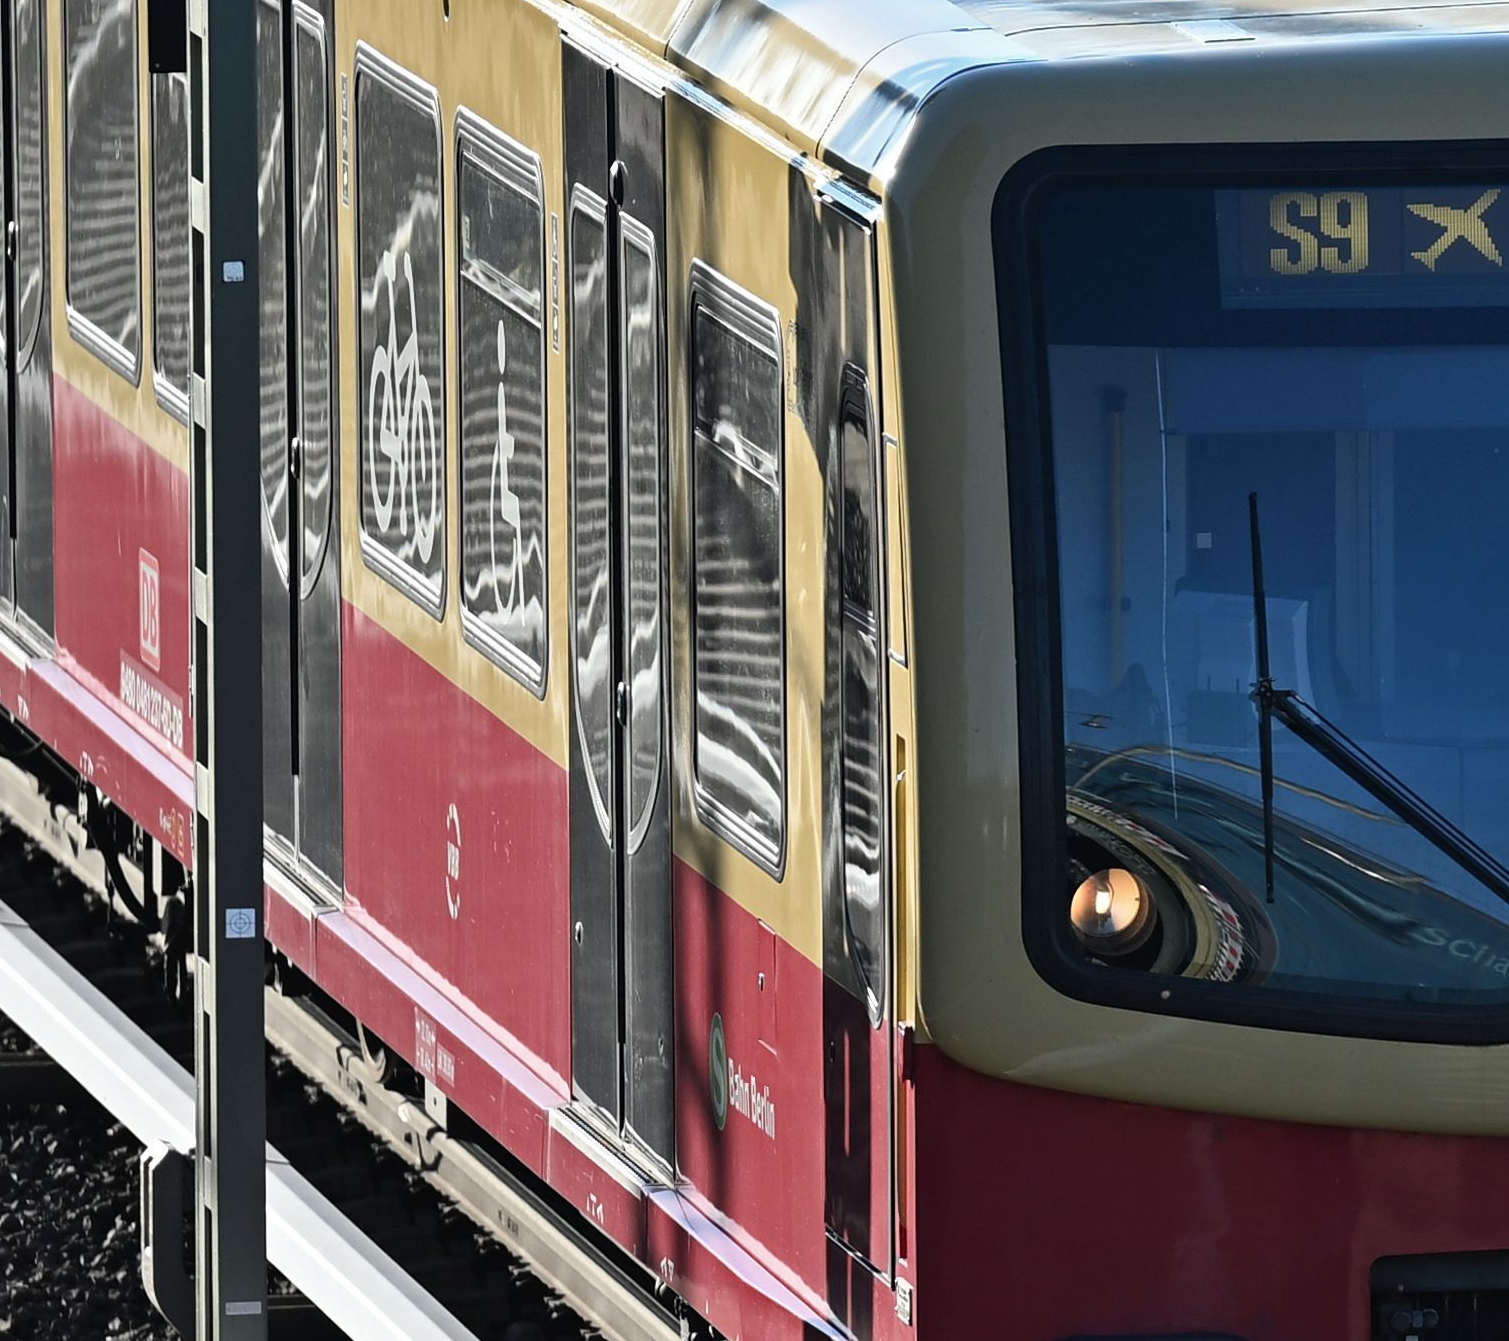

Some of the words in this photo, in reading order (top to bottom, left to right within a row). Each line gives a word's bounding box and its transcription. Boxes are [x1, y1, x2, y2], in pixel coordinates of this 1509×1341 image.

[1269, 191, 1370, 275] S9
[728, 1057, 750, 1119] Bahn
[750, 1074, 776, 1141] Berlin
